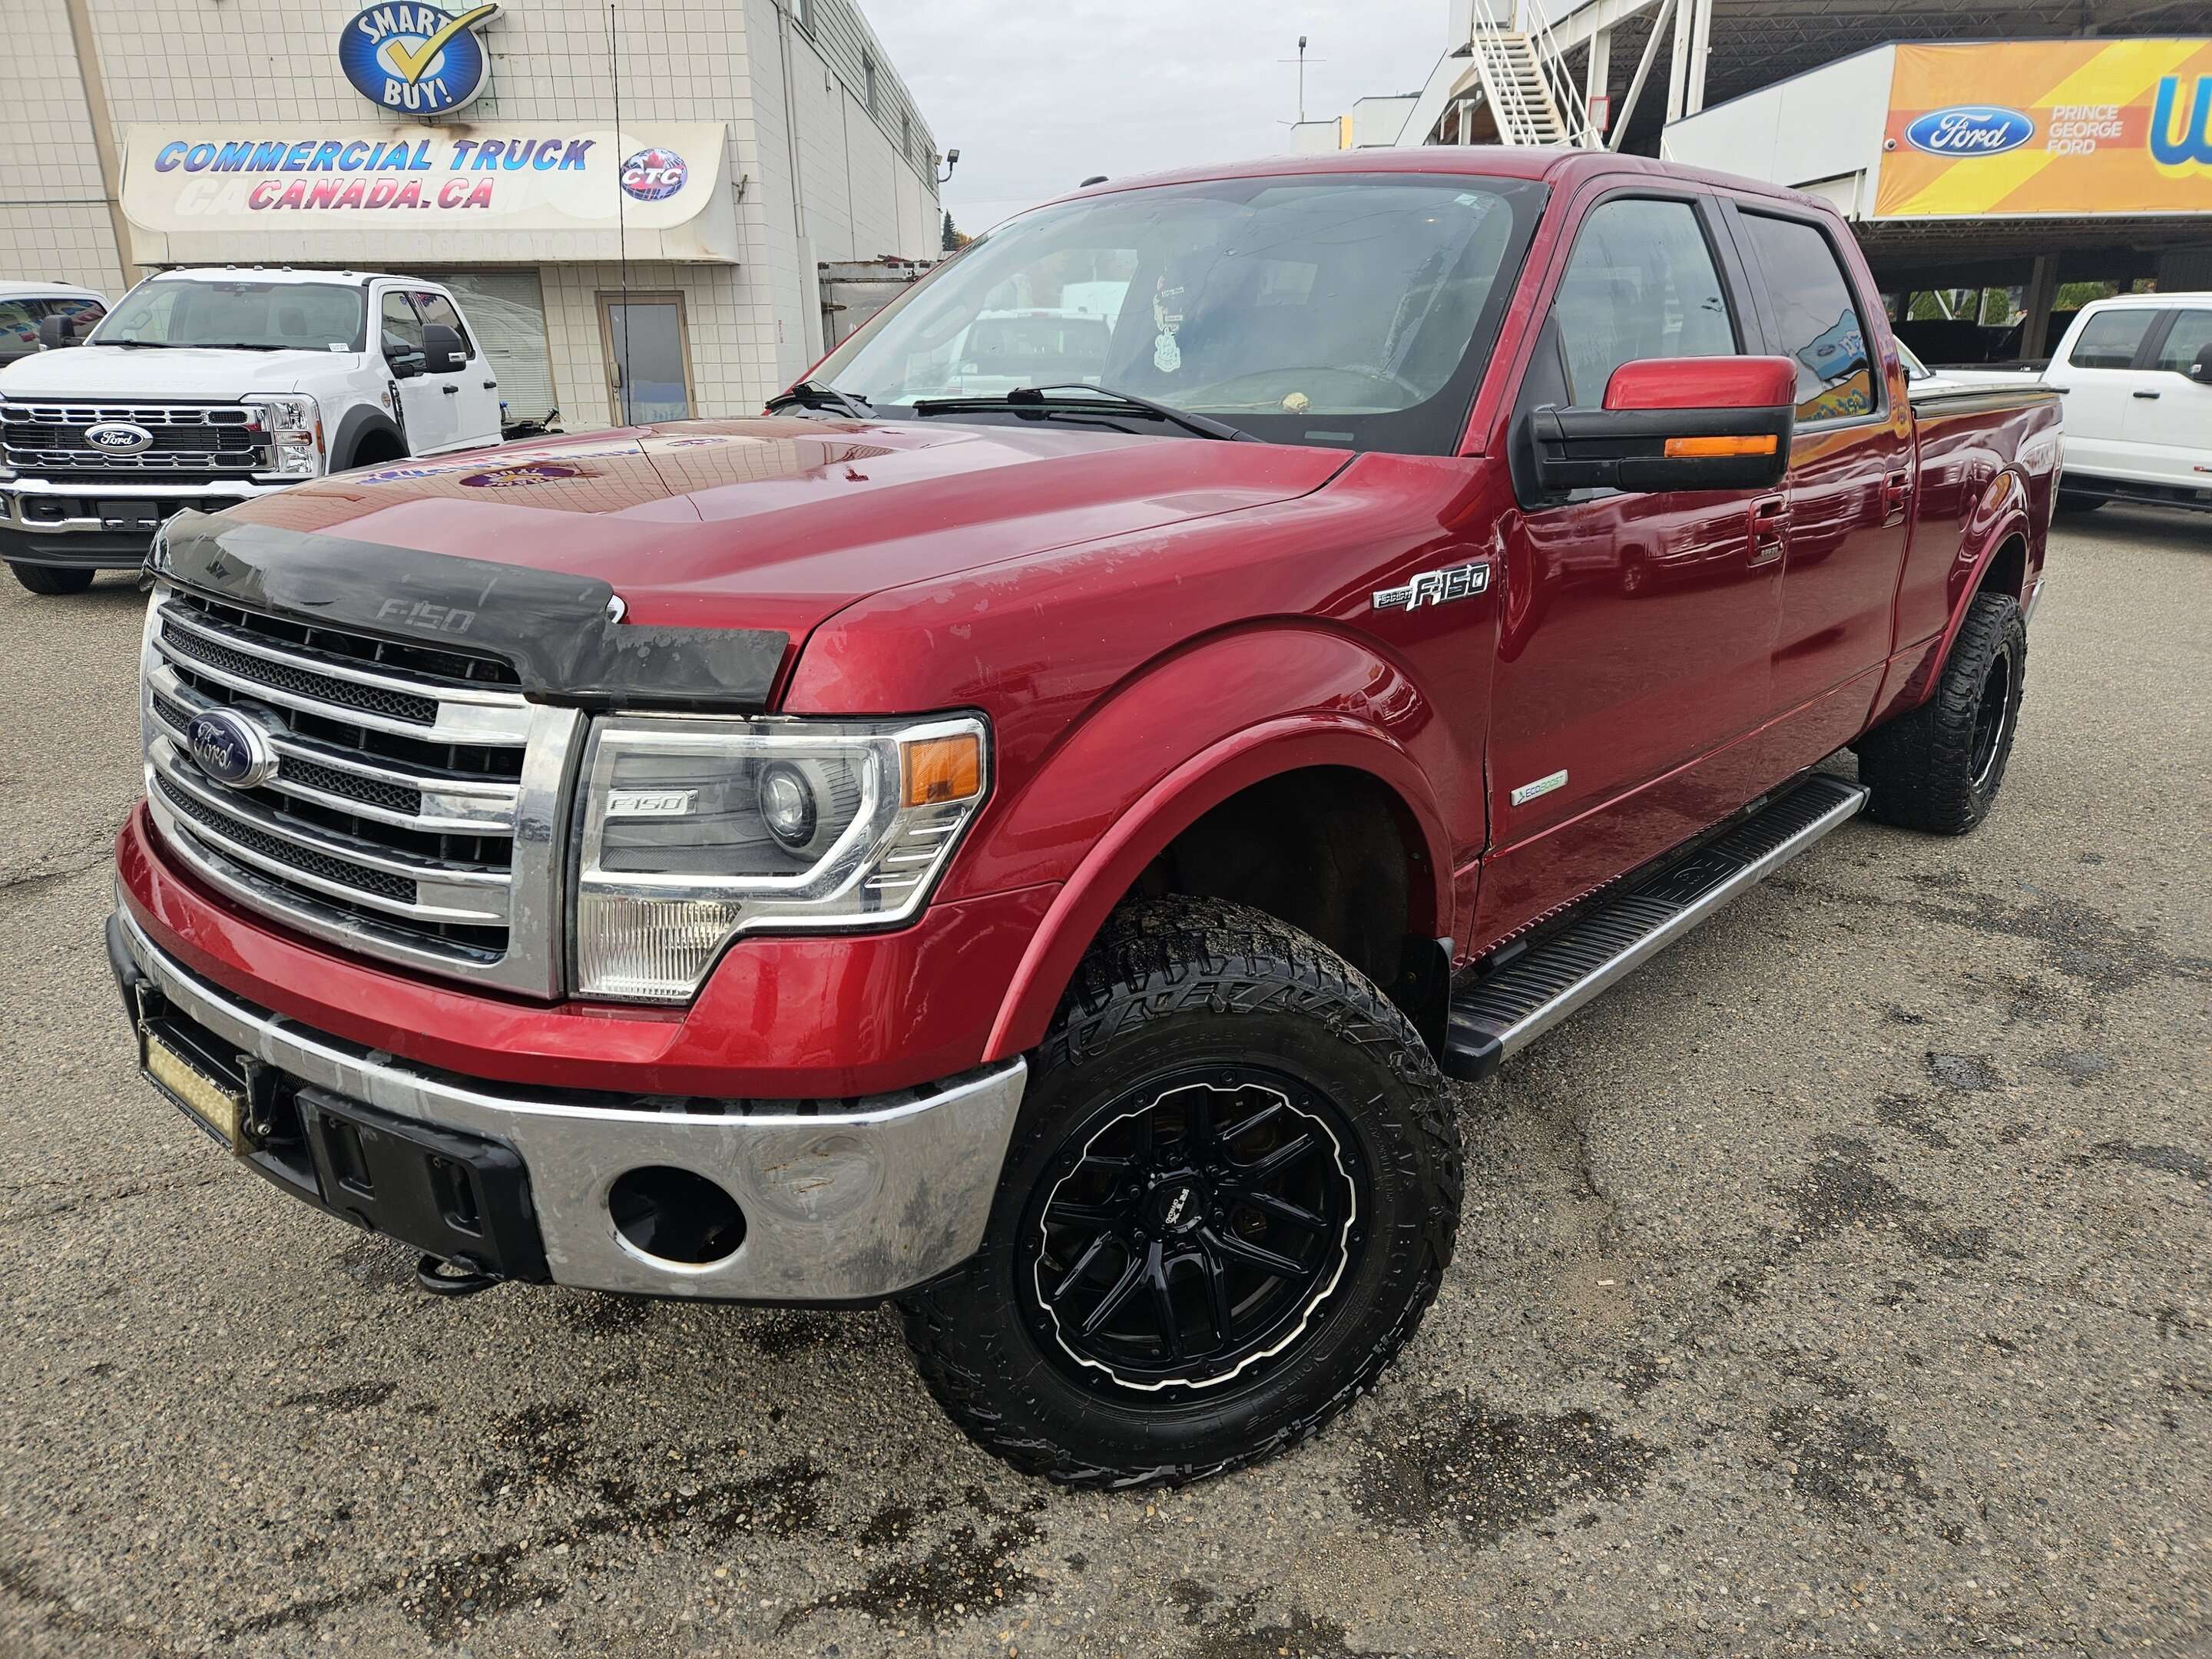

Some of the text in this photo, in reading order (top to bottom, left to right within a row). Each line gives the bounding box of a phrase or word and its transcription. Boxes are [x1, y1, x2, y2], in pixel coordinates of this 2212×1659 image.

[358, 5, 453, 45] SMART
[383, 77, 452, 110] BUY!
[2051, 104, 2118, 121] PRINCE
[1930, 113, 2011, 147] Ford
[2049, 121, 2124, 138] GEORGE
[154, 139, 596, 173] COMMERCIAL TRUCK
[2046, 138, 2096, 155] FORD
[621, 167, 682, 184] CTC
[247, 177, 494, 210] CANADA.CA
[100, 431, 133, 445] Ford
[194, 721, 233, 770] Ford
